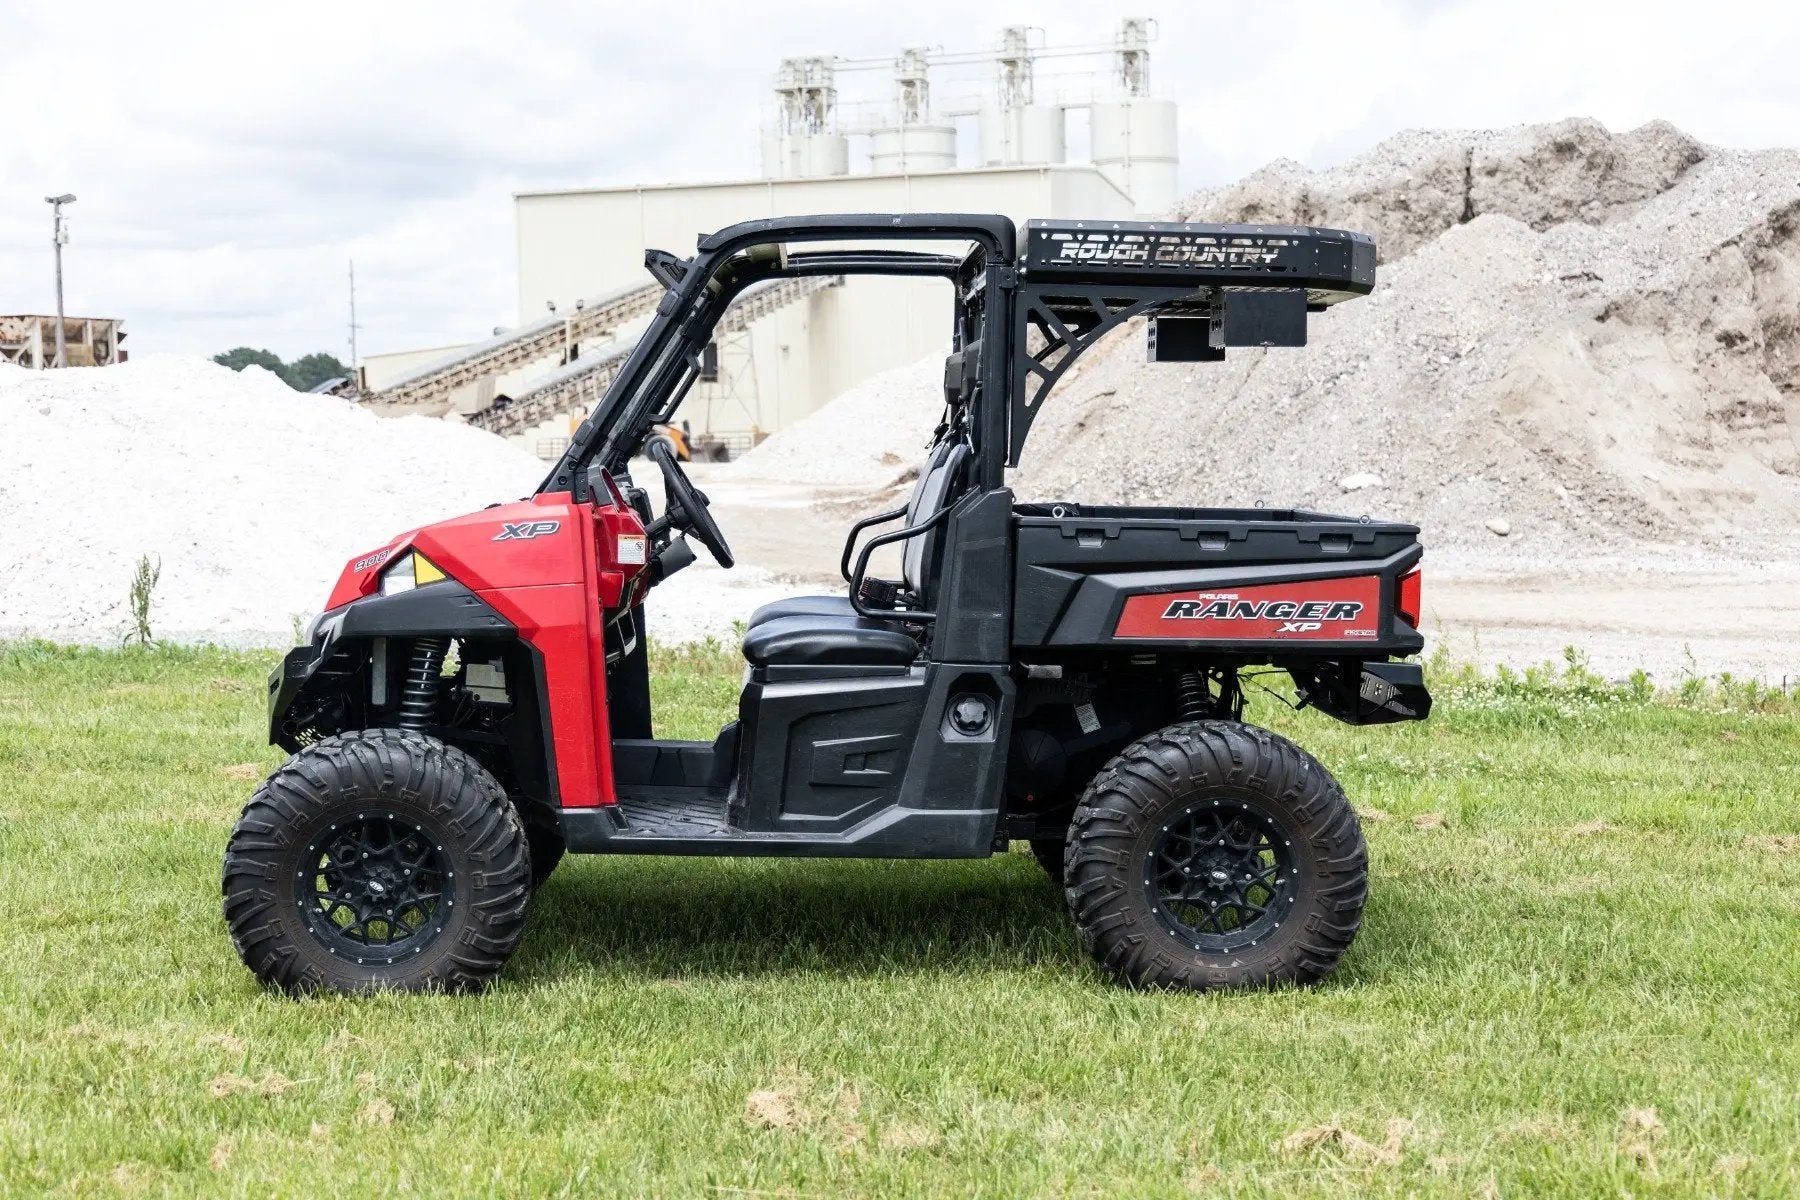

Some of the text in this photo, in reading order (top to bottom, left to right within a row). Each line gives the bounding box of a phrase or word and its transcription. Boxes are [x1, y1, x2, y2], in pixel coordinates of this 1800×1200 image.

[1060, 242, 1280, 264] ROUGH COUNTRY
[491, 521, 560, 540] XP
[1162, 600, 1363, 620] RANGER
[1275, 622, 1322, 632] XP
